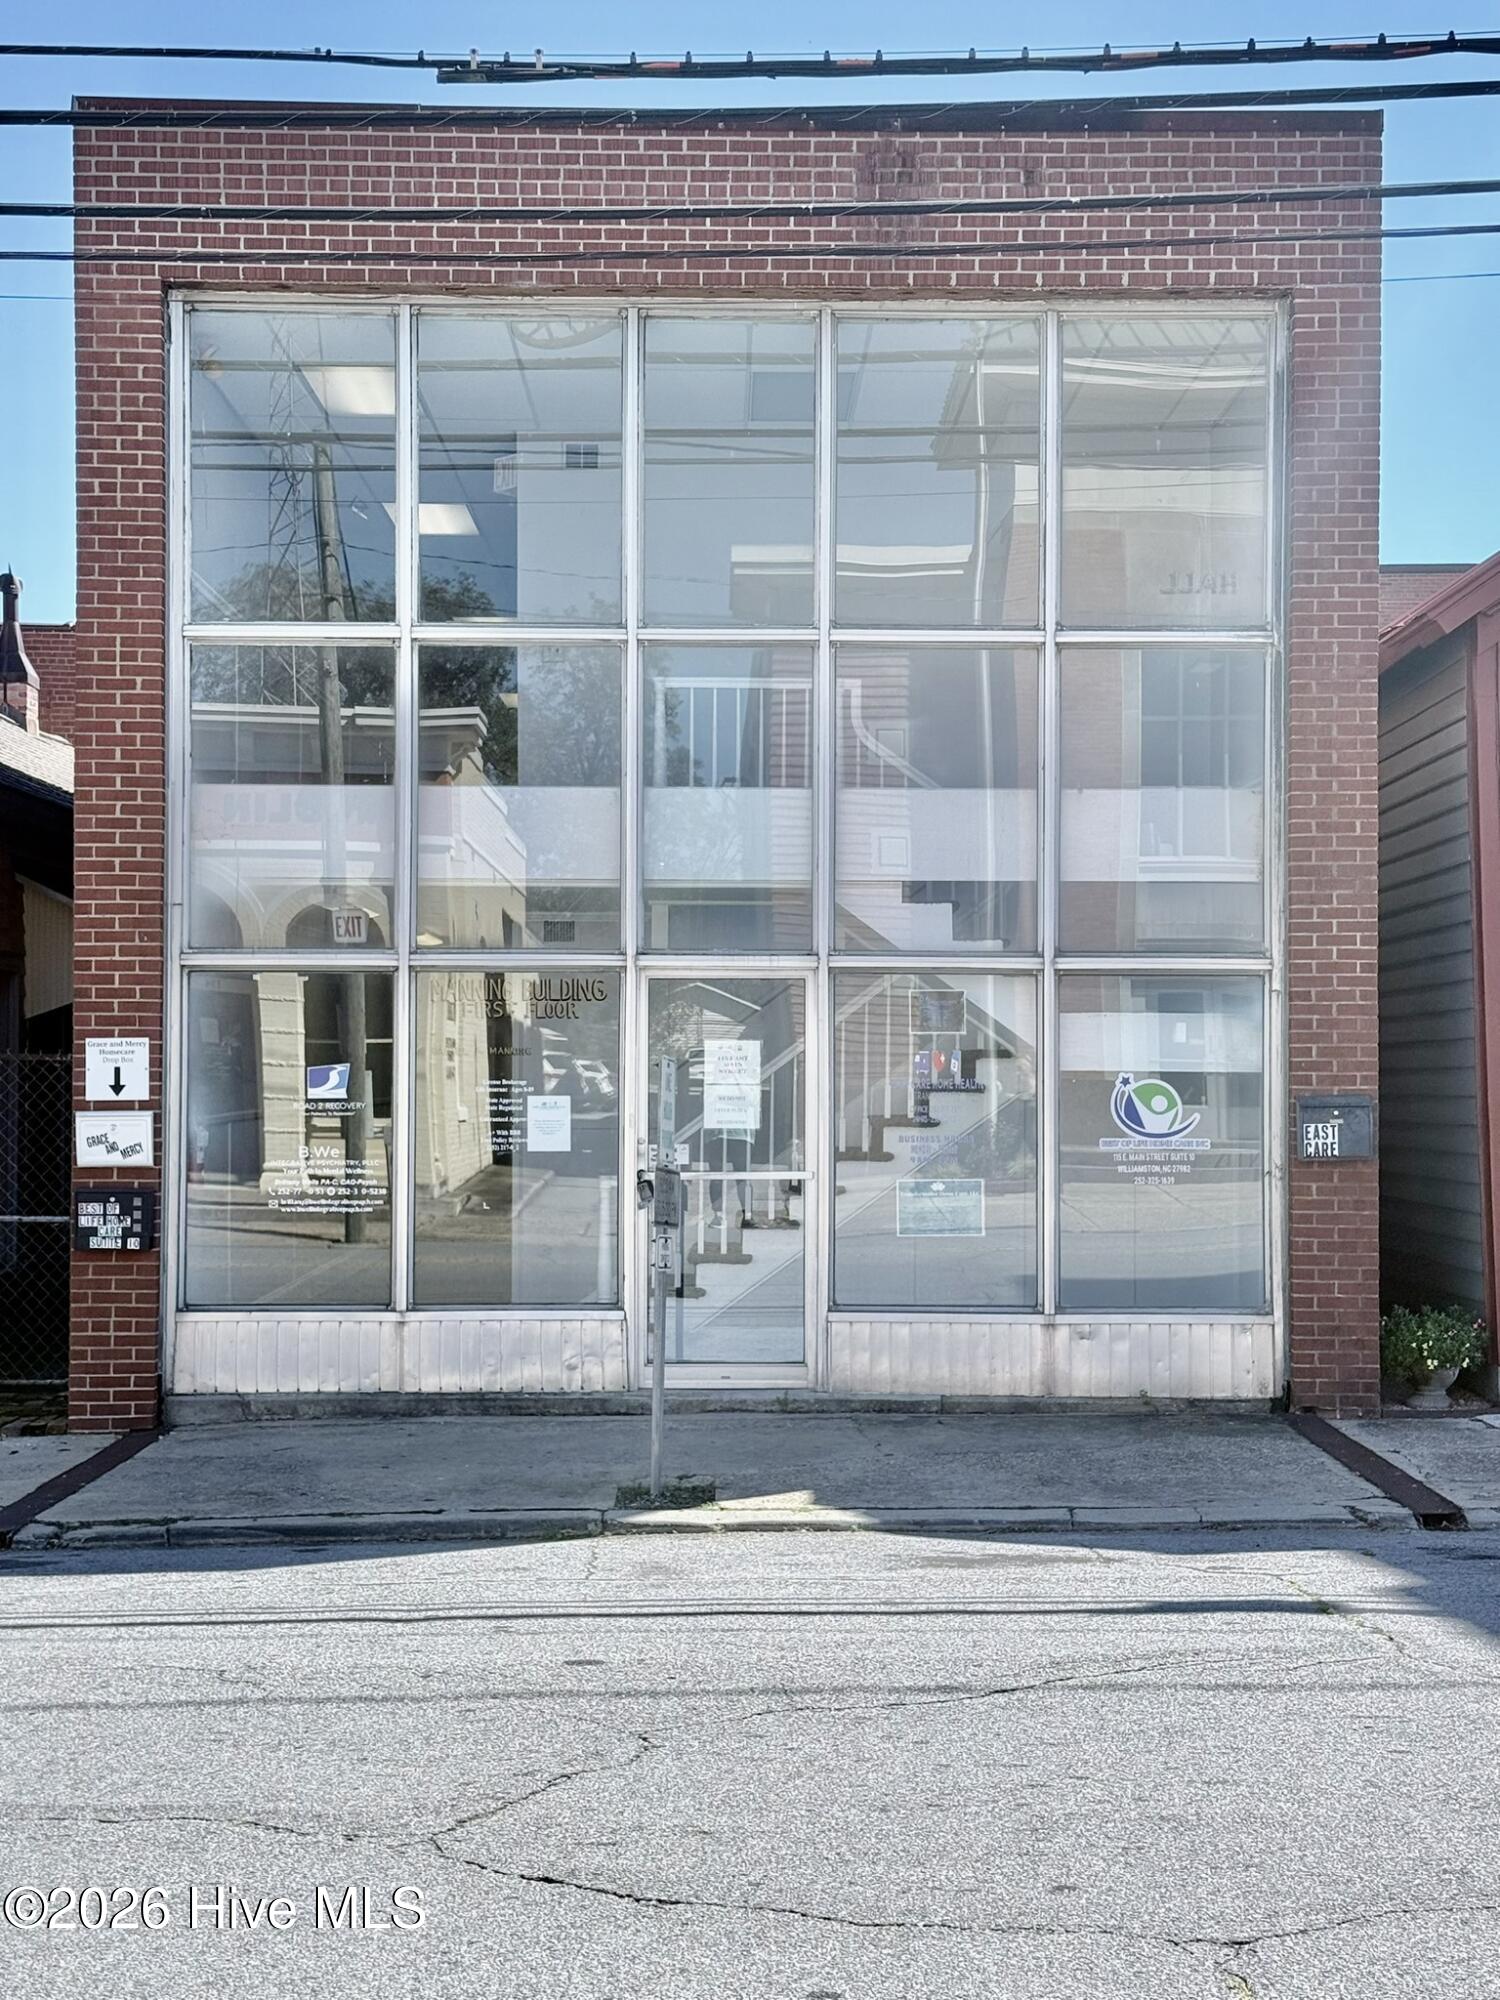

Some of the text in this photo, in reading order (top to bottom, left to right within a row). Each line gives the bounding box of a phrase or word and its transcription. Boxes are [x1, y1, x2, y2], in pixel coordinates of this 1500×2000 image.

[335, 916, 362, 938] EXIT
[430, 977, 608, 1001] MANNING BUILDING
[527, 1002, 579, 1019] FLOOR
[87, 1040, 108, 1048] Grace
[124, 1040, 147, 1049] Mercy
[956, 1077, 986, 1090] HEALTH
[293, 1102, 366, 1110] ROAD 2 RECOVERY
[1305, 1125, 1337, 1141] EAST
[86, 1133, 110, 1148] GRACE
[105, 1141, 119, 1155] AND
[120, 1142, 144, 1160] MERCY
[1304, 1141, 1338, 1157] CARE
[1146, 1152, 1169, 1160] STREET
[79, 1203, 119, 1214] BEST OF
[79, 1216, 131, 1228] LIFE HOME
[98, 1226, 122, 1236] CARE
[90, 1237, 140, 1249] SUITE 10
